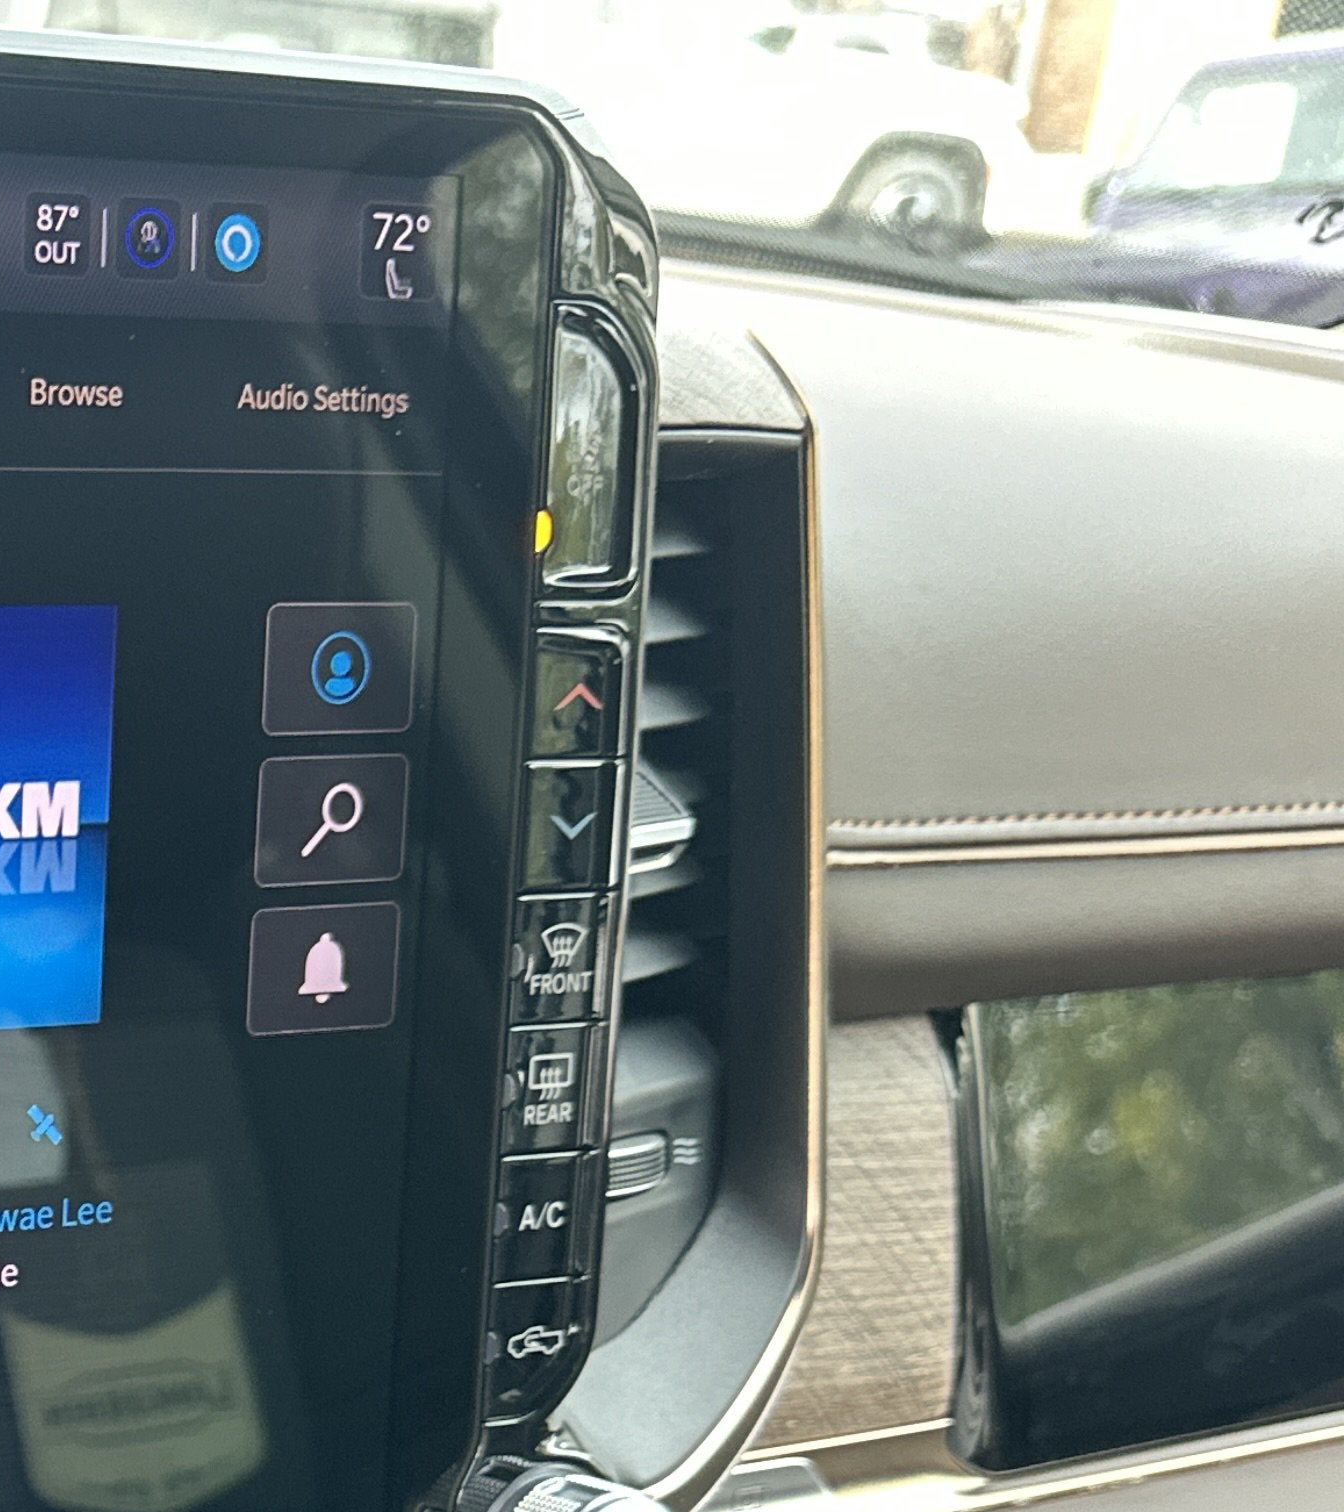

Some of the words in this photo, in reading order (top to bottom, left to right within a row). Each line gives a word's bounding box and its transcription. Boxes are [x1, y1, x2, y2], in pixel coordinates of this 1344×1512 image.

[36, 203, 80, 232] 87°
[373, 211, 431, 252] 72°
[34, 239, 81, 265] OUT
[30, 377, 124, 408] Browse
[237, 382, 308, 411] Audio
[313, 385, 410, 418] Settings
[529, 970, 592, 995] FRONT
[523, 1103, 572, 1126] REAR
[62, 1197, 113, 1227] Lee
[518, 1202, 566, 1232] A/C
